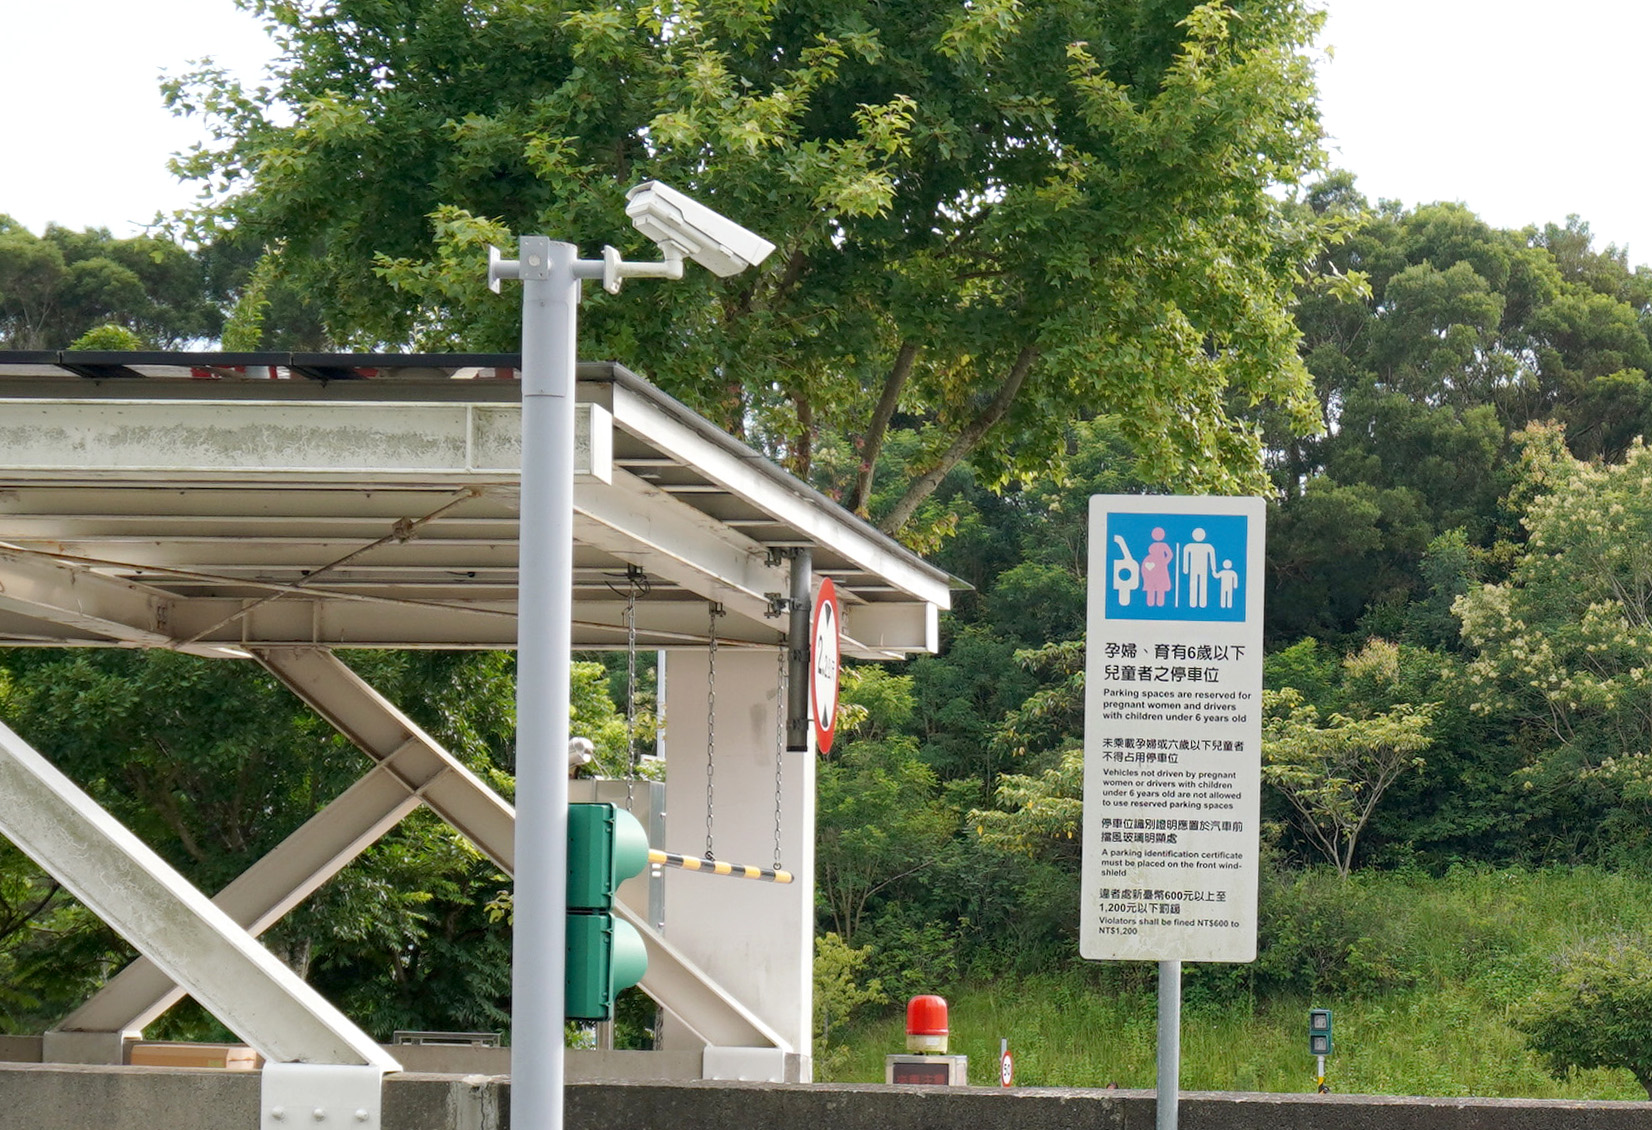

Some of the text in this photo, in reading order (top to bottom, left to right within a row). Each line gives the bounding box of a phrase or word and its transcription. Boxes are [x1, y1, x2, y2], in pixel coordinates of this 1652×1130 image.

[1104, 642, 1246, 660] 孕婦、育有6歲以下
[1104, 665, 1219, 682] 兒童者之停車位
[1104, 689, 1139, 698] Parking
[1142, 690, 1174, 699] spaces
[1195, 691, 1235, 699] reserved
[1103, 702, 1144, 710] pregnant
[1103, 752, 1178, 763] 不得占用停車位
[1103, 769, 1138, 777] Vehicles
[1157, 770, 1183, 778] driven
[1186, 771, 1196, 779] by
[1199, 772, 1236, 780] pregnant
[1147, 780, 1175, 788] drivers
[1209, 791, 1241, 799] allowed
[1170, 802, 1201, 810] parking
[1101, 833, 1177, 844] 擋風玻璃明顯處
[1110, 850, 1142, 859] parking
[1144, 850, 1199, 858] identification
[1201, 851, 1242, 859] certificate
[1137, 860, 1165, 868] placed
[1099, 917, 1136, 925] Violators
[1004, 1064, 1011, 1076] 50
